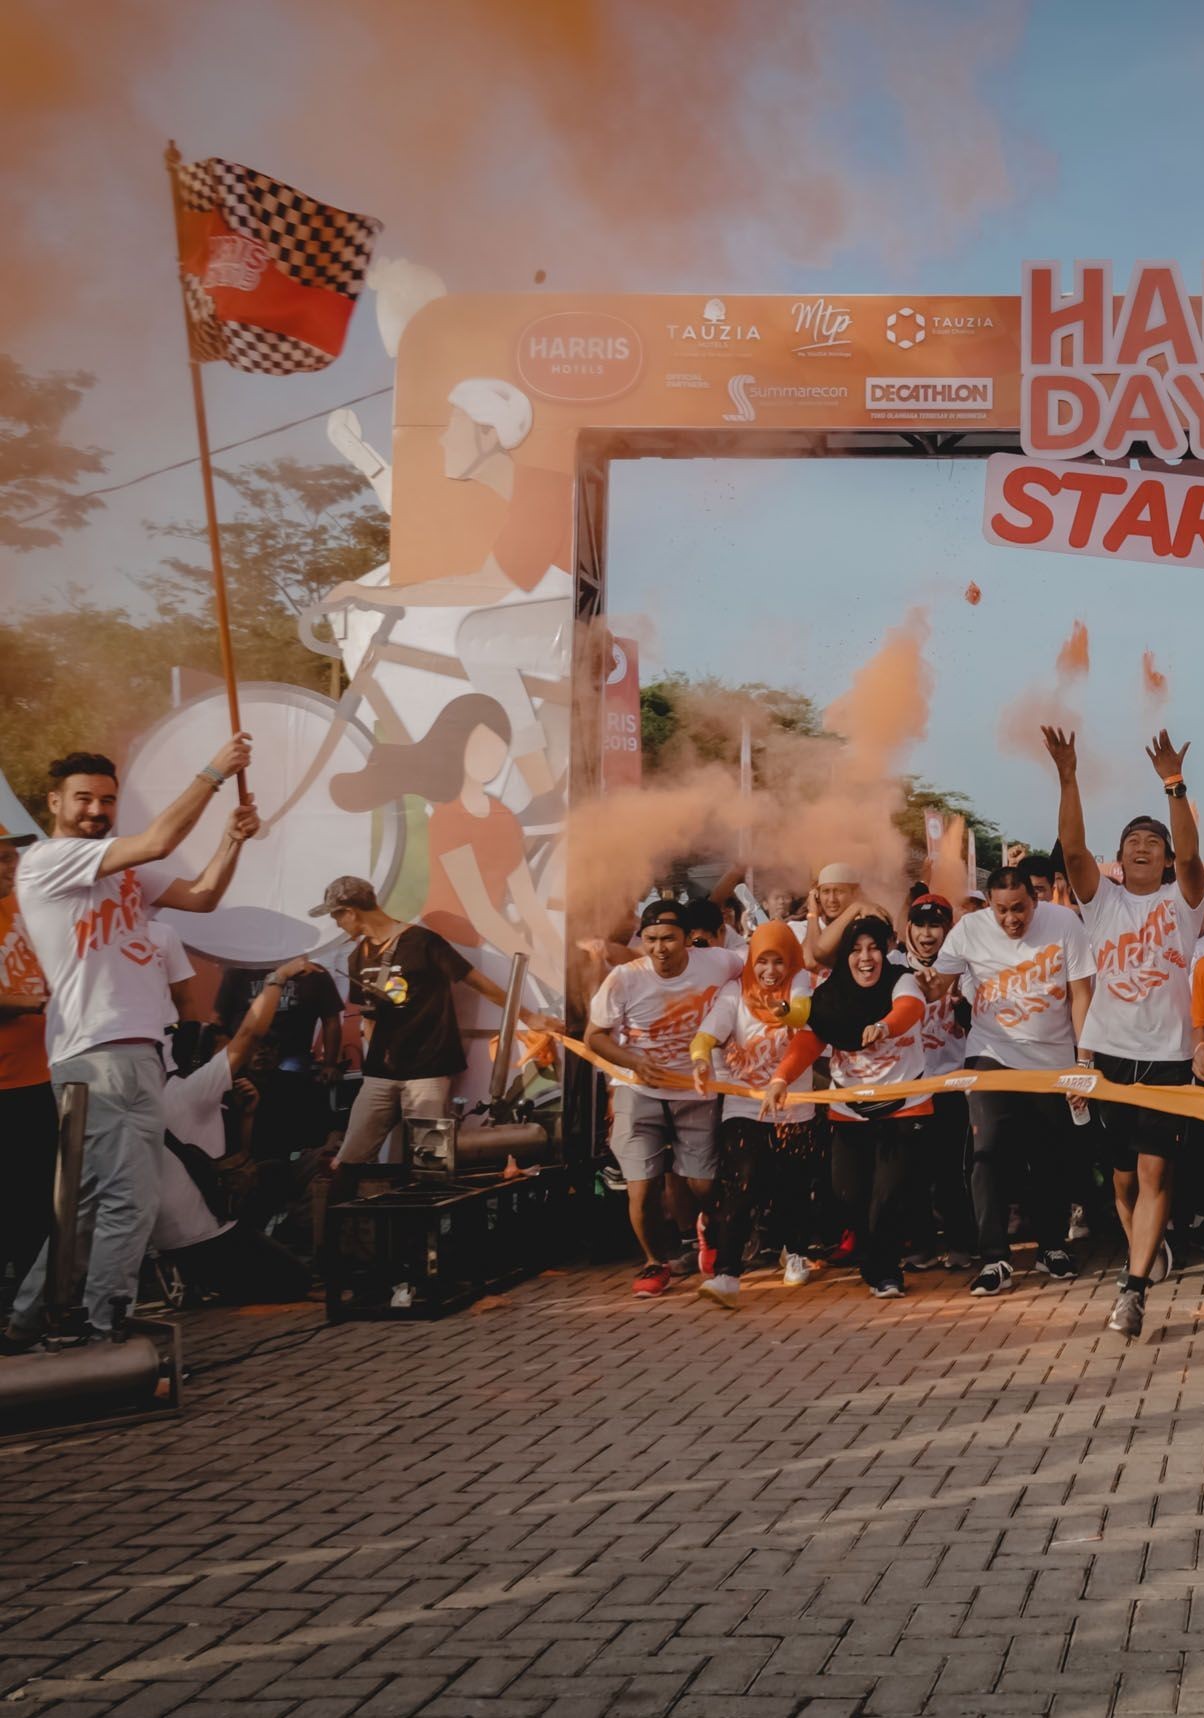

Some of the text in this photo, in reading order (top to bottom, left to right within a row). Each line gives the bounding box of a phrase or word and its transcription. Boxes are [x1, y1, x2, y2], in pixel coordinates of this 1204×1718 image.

[792, 299, 853, 345] Mtp
[932, 317, 994, 328] TAUZIA
[667, 325, 761, 340] TAUZIA
[529, 336, 631, 360] HARRIS
[551, 364, 605, 375] HOTELS
[870, 383, 988, 403] DECATHLON
[607, 711, 637, 734] RIS
